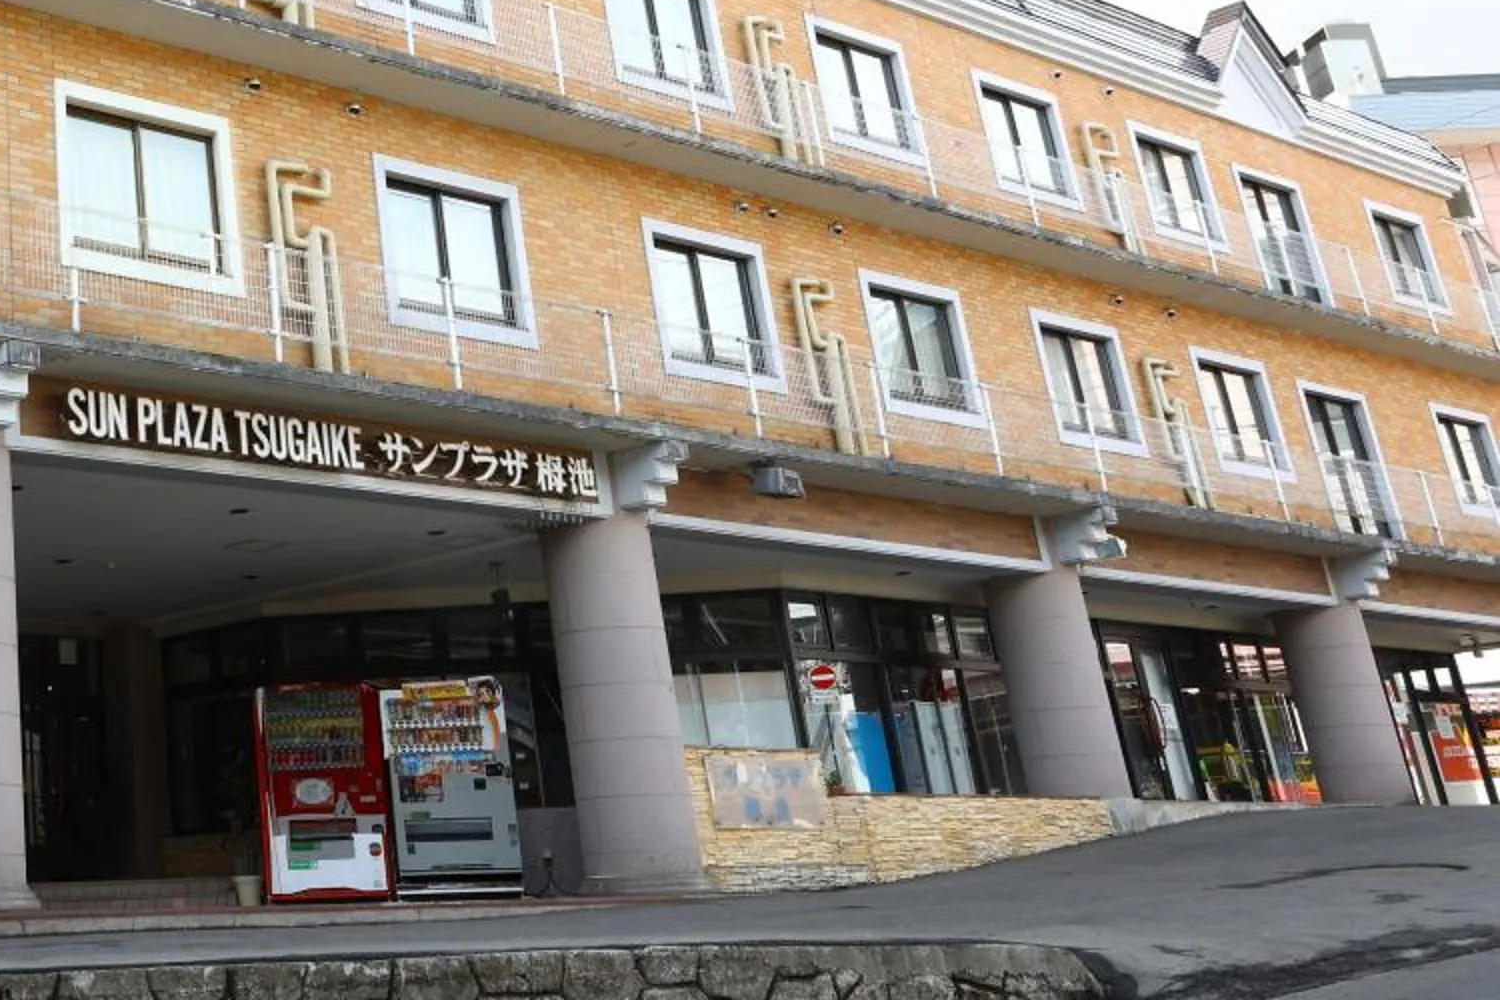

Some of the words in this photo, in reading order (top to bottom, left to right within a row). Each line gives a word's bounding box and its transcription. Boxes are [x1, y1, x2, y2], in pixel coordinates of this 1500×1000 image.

[67, 387, 129, 441] SUN
[137, 396, 231, 453] PLAZA
[233, 410, 366, 469] TSUGAIKE
[378, 432, 528, 488] サンプラザ
[535, 453, 597, 497] 栂池
